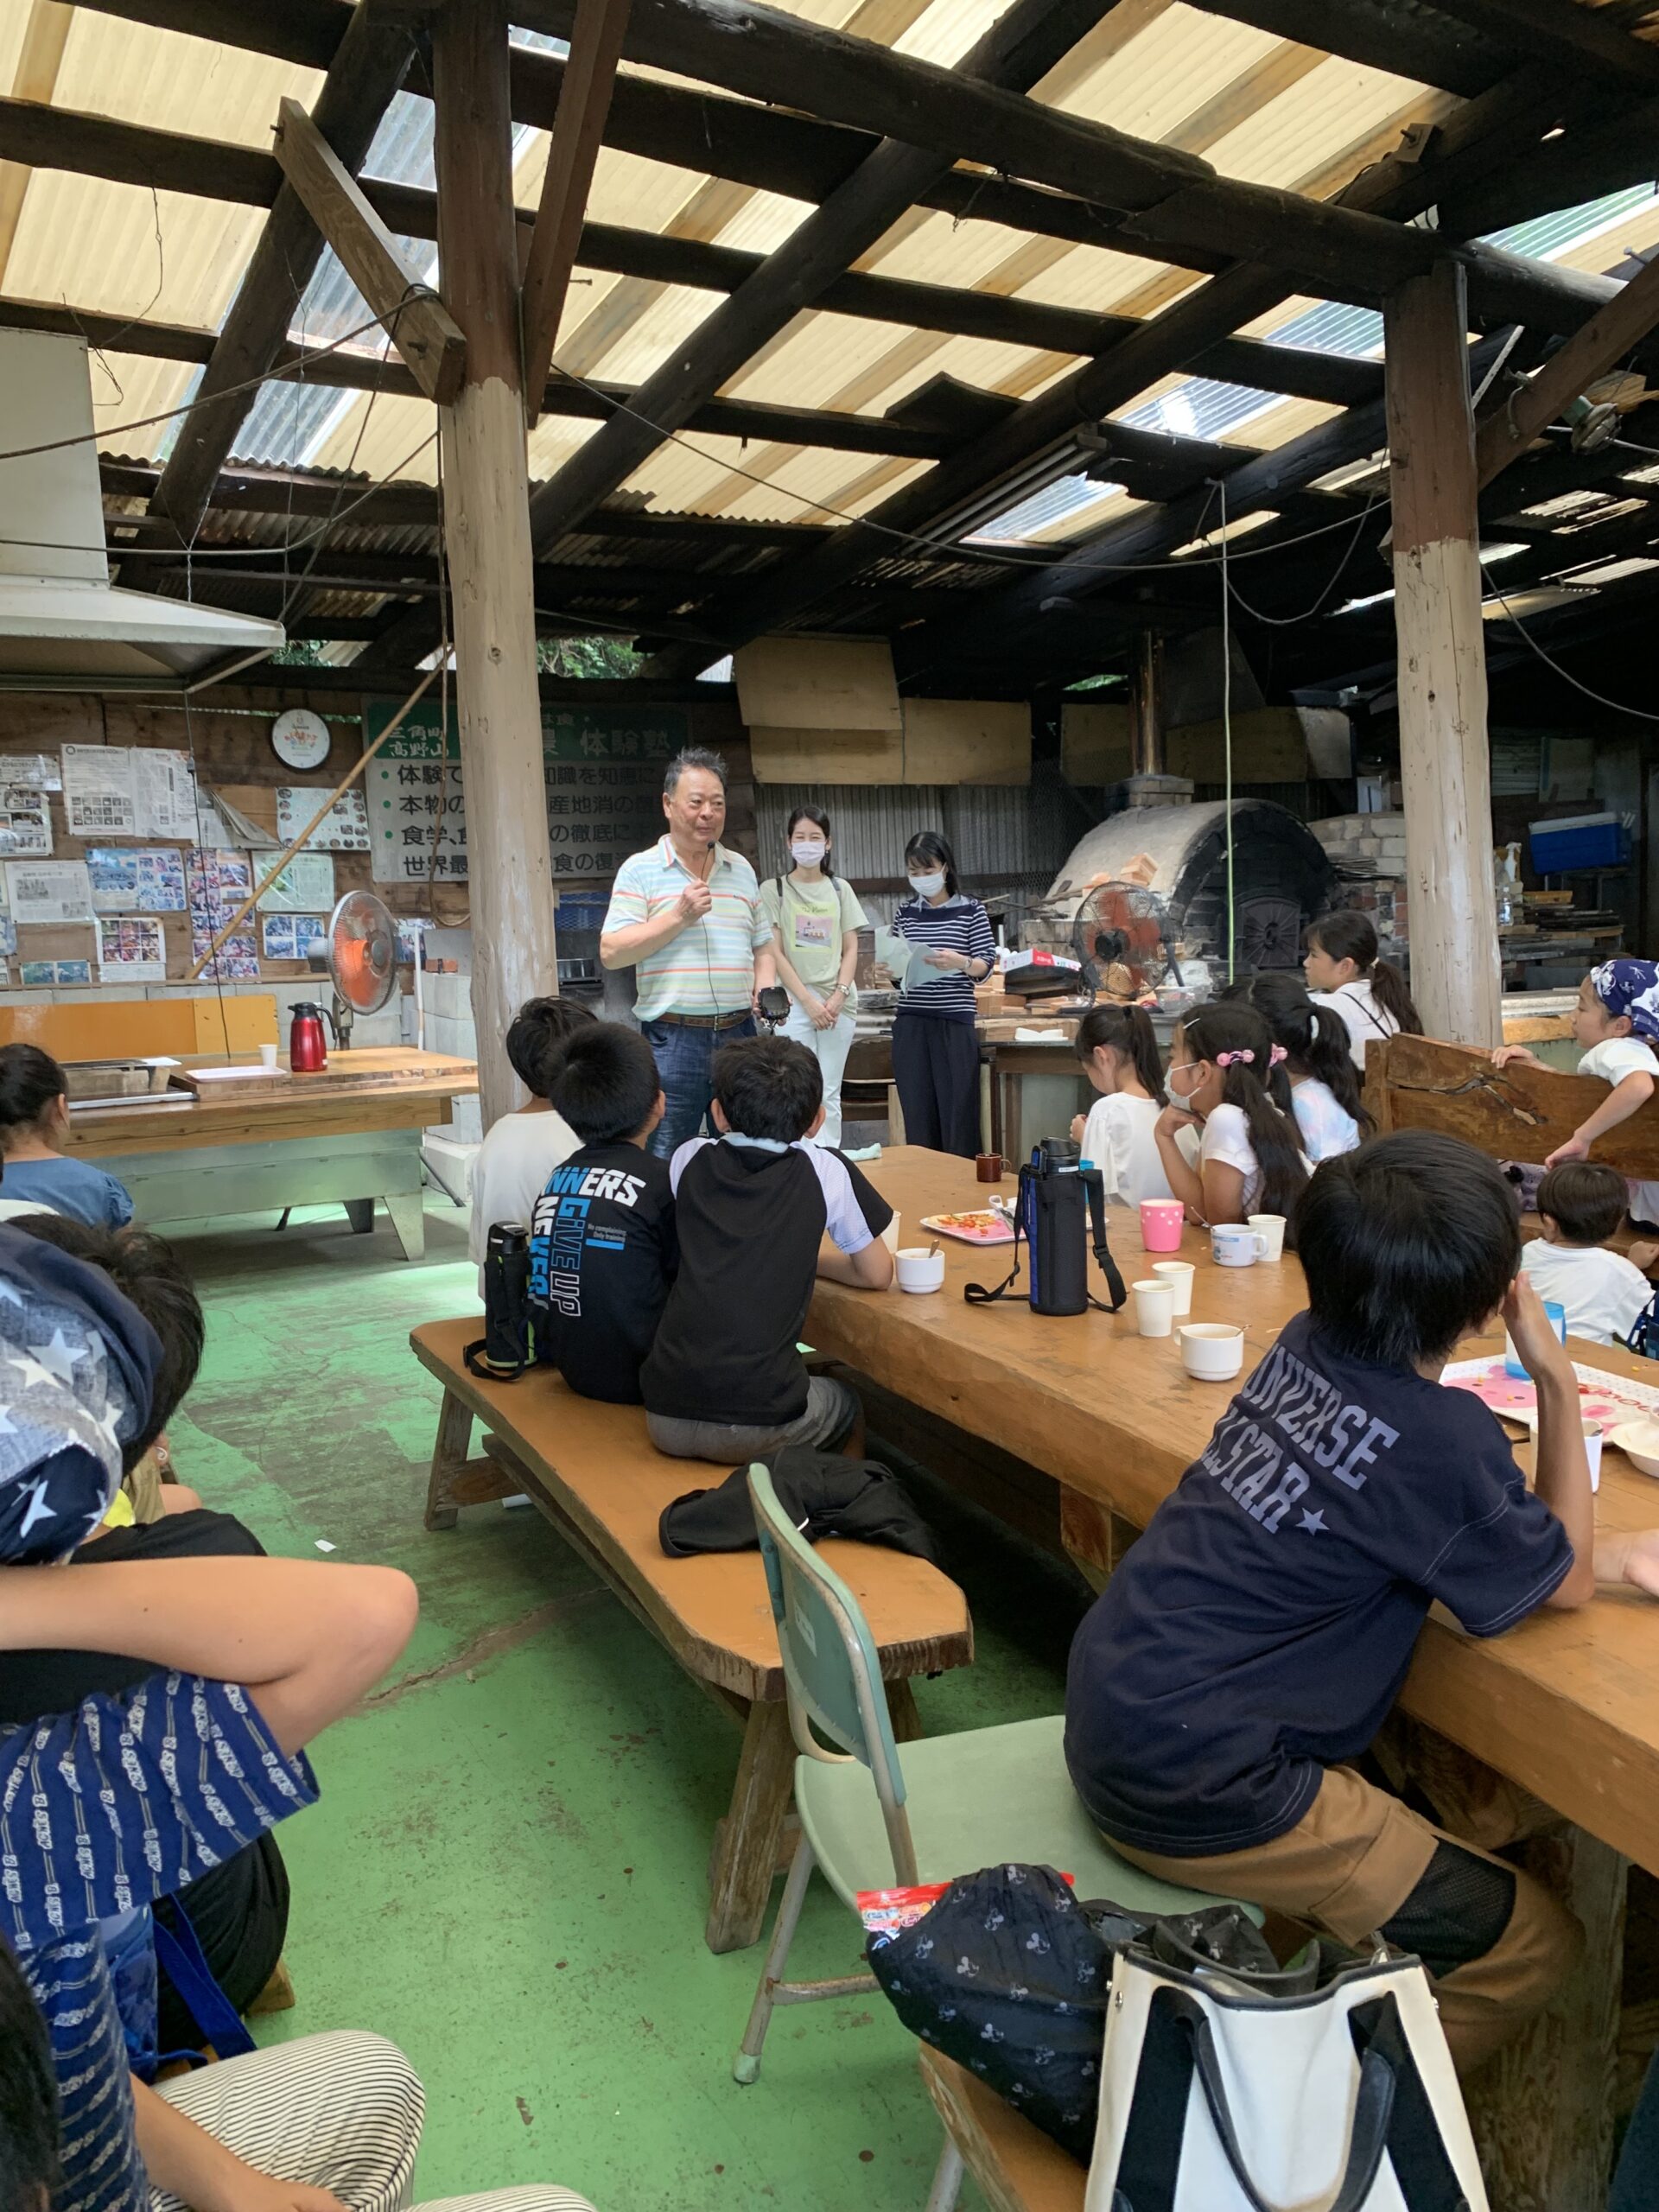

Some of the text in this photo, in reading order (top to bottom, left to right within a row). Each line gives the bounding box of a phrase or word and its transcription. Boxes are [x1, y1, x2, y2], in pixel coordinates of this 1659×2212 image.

[548, 794, 662, 816] 産地消の
[549, 823, 653, 843] の徹底に
[550, 1270, 582, 1317] UP
